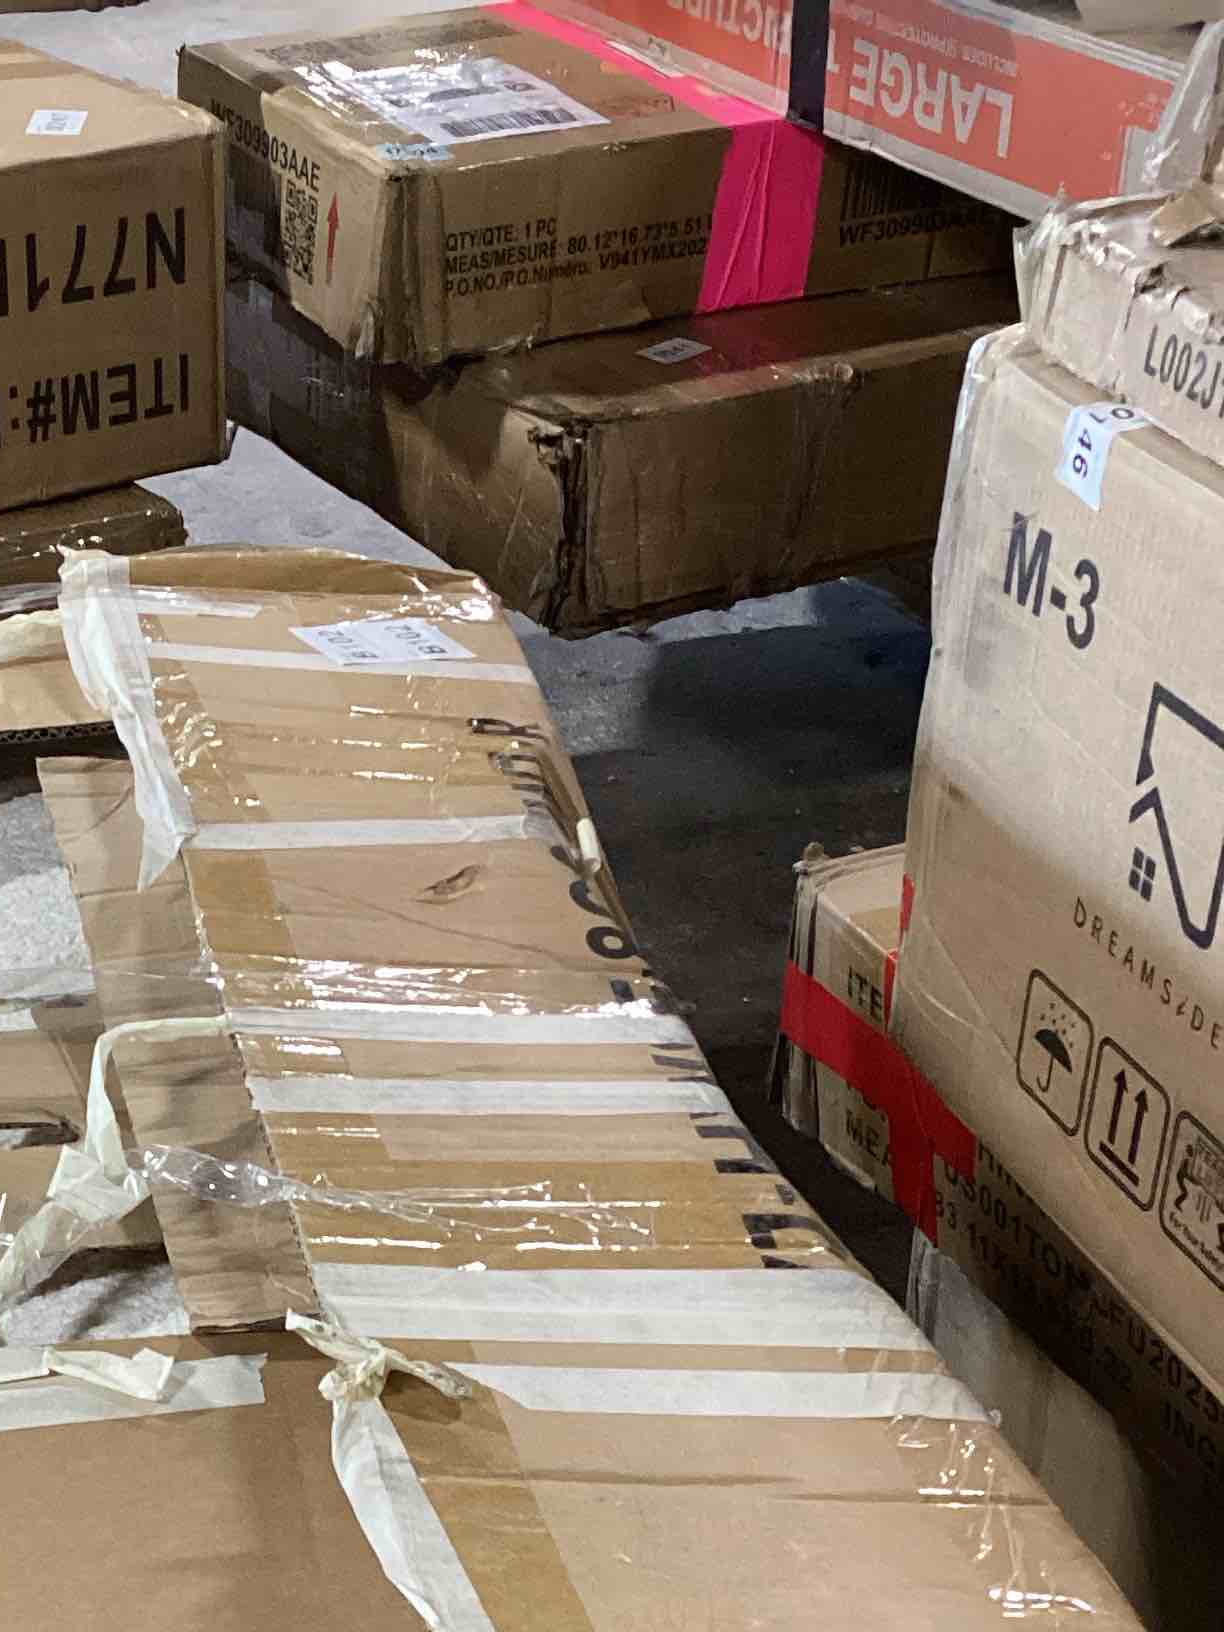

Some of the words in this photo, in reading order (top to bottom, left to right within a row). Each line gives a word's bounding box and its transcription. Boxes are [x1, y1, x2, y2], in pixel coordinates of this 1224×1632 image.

[849, 38, 1014, 160] LARGE
[1143, 323, 1224, 419] L002J
[1002, 511, 1101, 650] M-3
